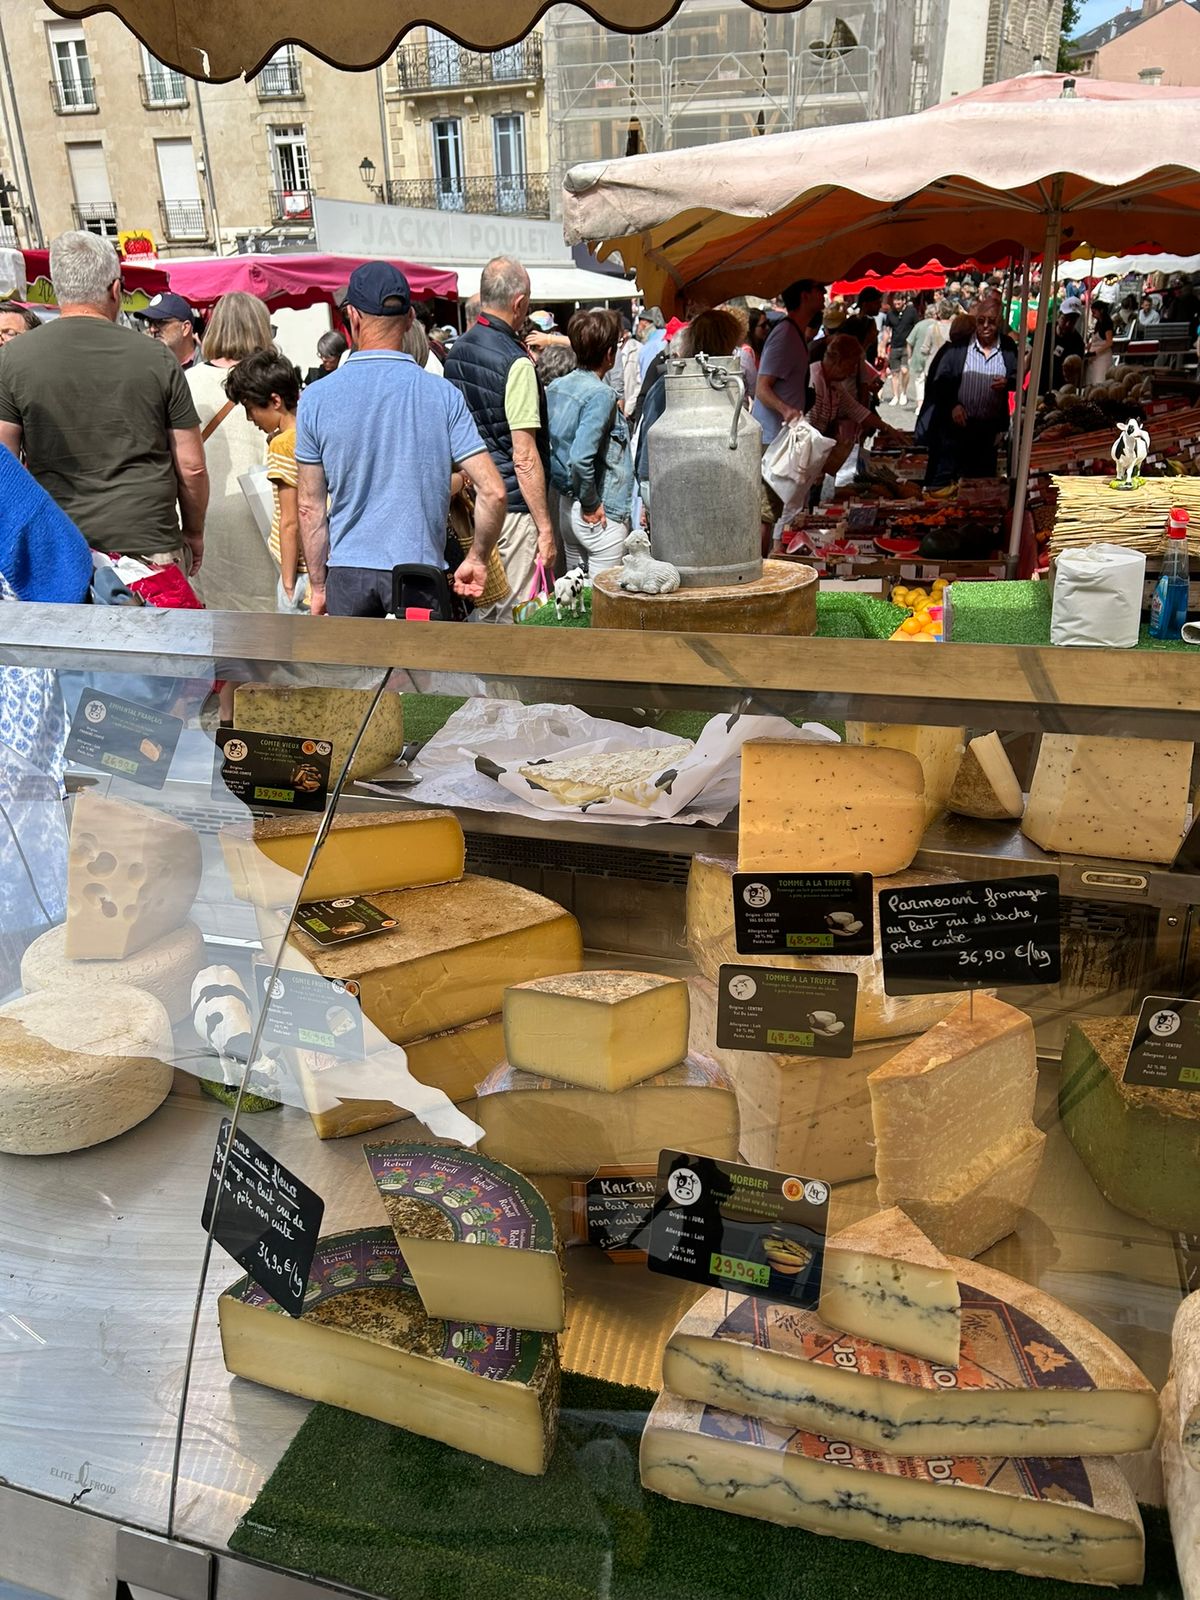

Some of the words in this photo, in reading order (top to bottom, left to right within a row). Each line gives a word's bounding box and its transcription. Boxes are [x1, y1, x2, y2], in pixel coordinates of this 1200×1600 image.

[470, 224, 547, 252] POULET
[282, 741, 300, 750] VIEUX
[256, 788, 283, 800] 38,90
[888, 895, 978, 912] Parmesan
[984, 888, 1047, 908] fromage
[887, 925, 906, 934] au
[909, 920, 939, 932] lait
[932, 931, 971, 946] cuite
[958, 950, 1005, 966] 36,90
[1015, 940, 1050, 967] €/kg
[765, 974, 789, 982] TOMME
[810, 977, 836, 985] TRUFFE
[430, 1163, 458, 1174] Rebell
[470, 1176, 494, 1192] Rebell
[730, 1173, 768, 1189] MORBIER
[258, 1181, 275, 1206] lait
[292, 1213, 306, 1232] de
[499, 1198, 516, 1218] Rebell
[604, 1202, 629, 1210] lait
[256, 1208, 269, 1222] non
[272, 1219, 295, 1240] cuite
[669, 1211, 688, 1220] Origine
[692, 1216, 704, 1224] JURA
[322, 1253, 352, 1266] Rebell
[669, 1253, 682, 1262] Poids
[684, 1256, 696, 1265] total
[760, 1268, 765, 1277] €
[495, 1327, 505, 1350] Rebell
[50, 1466, 75, 1482] ELITE
[89, 1479, 117, 1495] FROID
